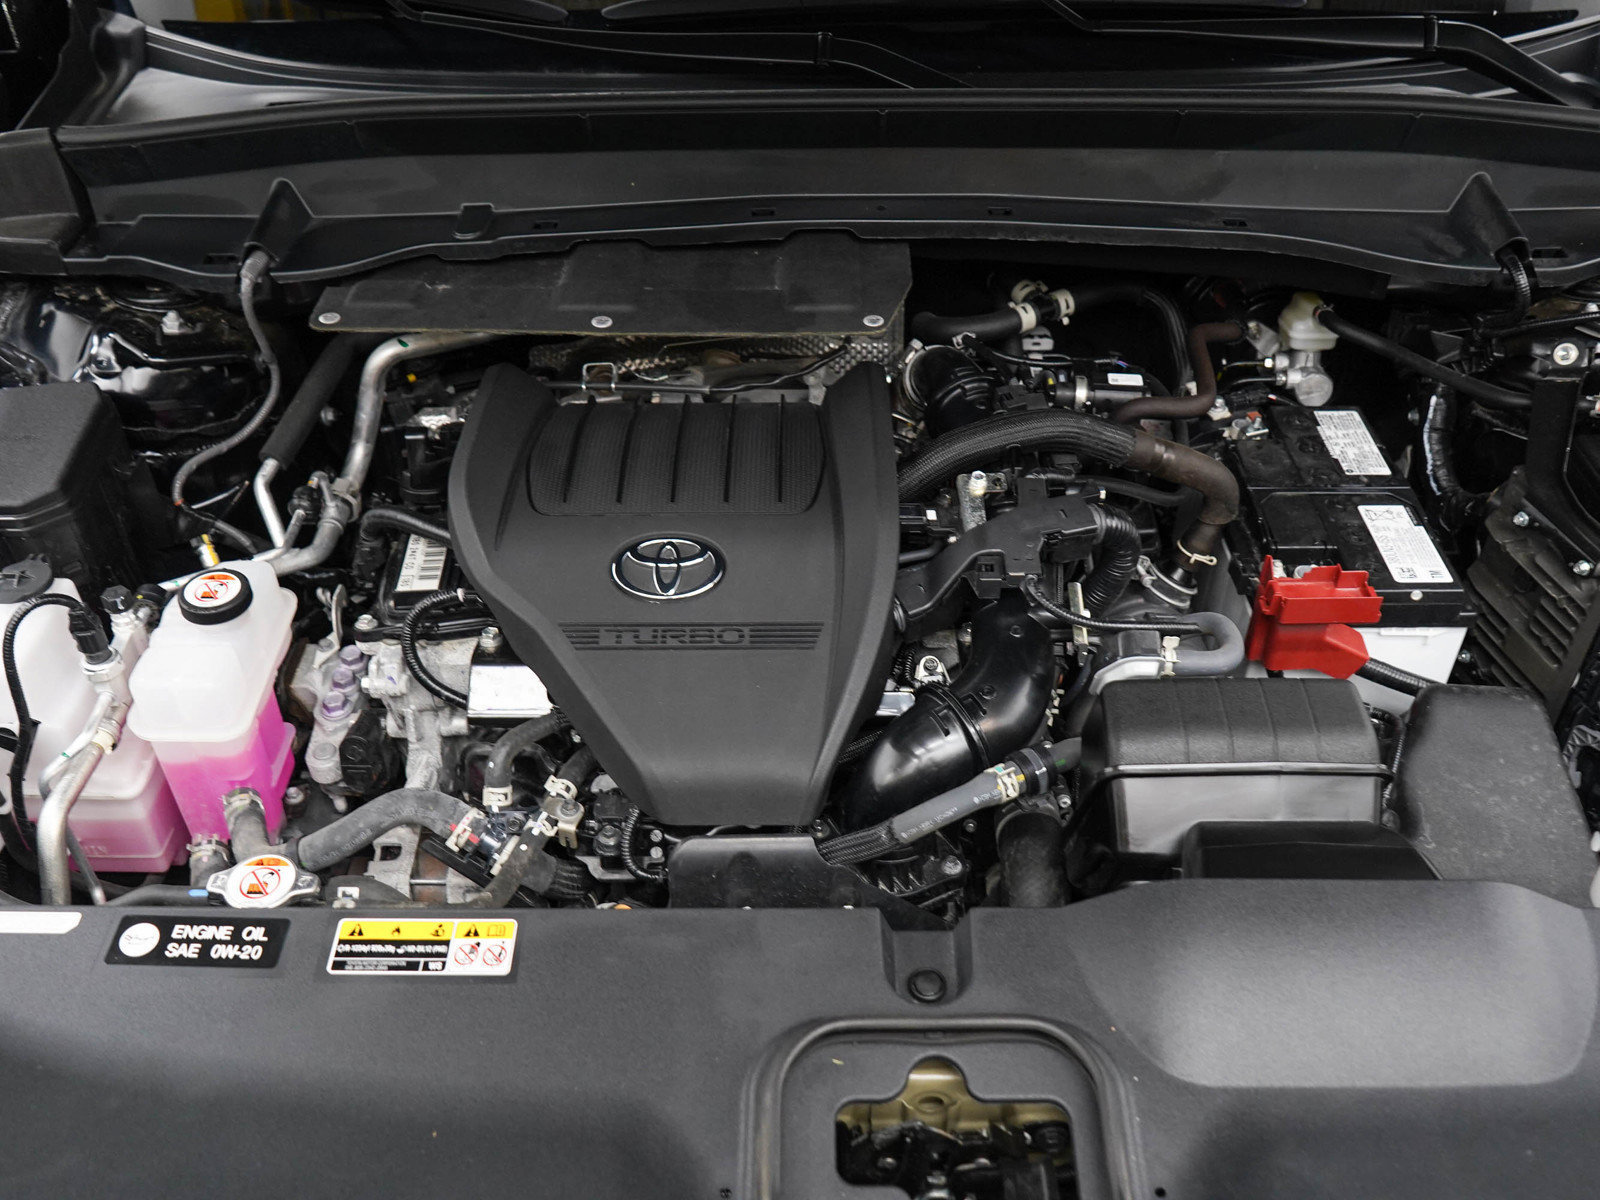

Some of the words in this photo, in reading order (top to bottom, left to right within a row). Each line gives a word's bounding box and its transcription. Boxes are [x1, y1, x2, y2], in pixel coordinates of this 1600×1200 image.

[604, 627, 746, 645] TURBO
[171, 925, 235, 940] ENGINE
[241, 926, 269, 942] OIL
[165, 943, 202, 958] SAE
[210, 945, 263, 960] 0W-20
